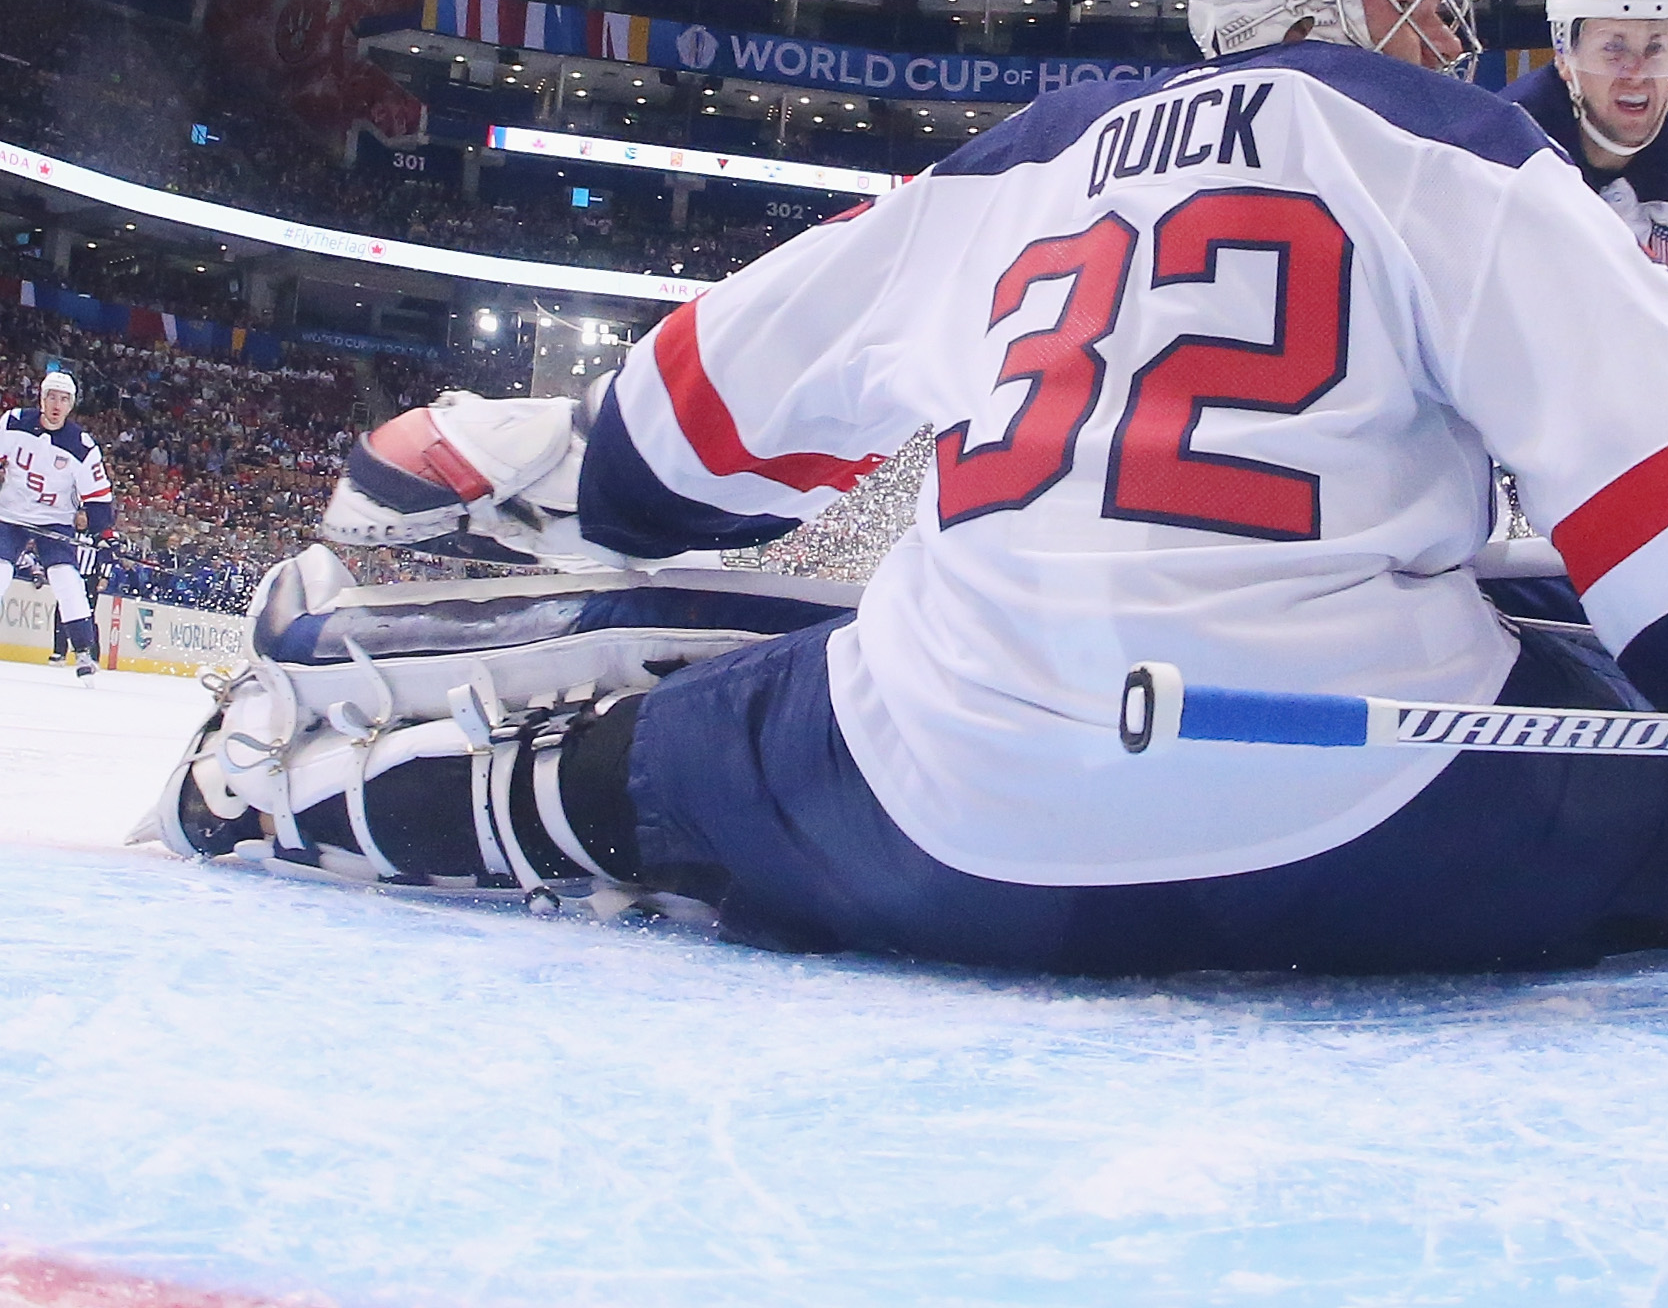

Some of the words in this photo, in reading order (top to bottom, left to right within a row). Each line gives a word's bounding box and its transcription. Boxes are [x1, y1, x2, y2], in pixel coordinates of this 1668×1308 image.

[730, 34, 897, 90] WORLD
[904, 58, 999, 94] CUP
[1004, 68, 1032, 87] OF
[1087, 81, 1275, 199] QUICK
[392, 151, 426, 172] 301
[766, 201, 804, 220] 302
[283, 224, 367, 260] #FlyTheFlag
[658, 282, 689, 297] AIR
[935, 186, 1355, 542] 32
[169, 621, 218, 652] WORLD
